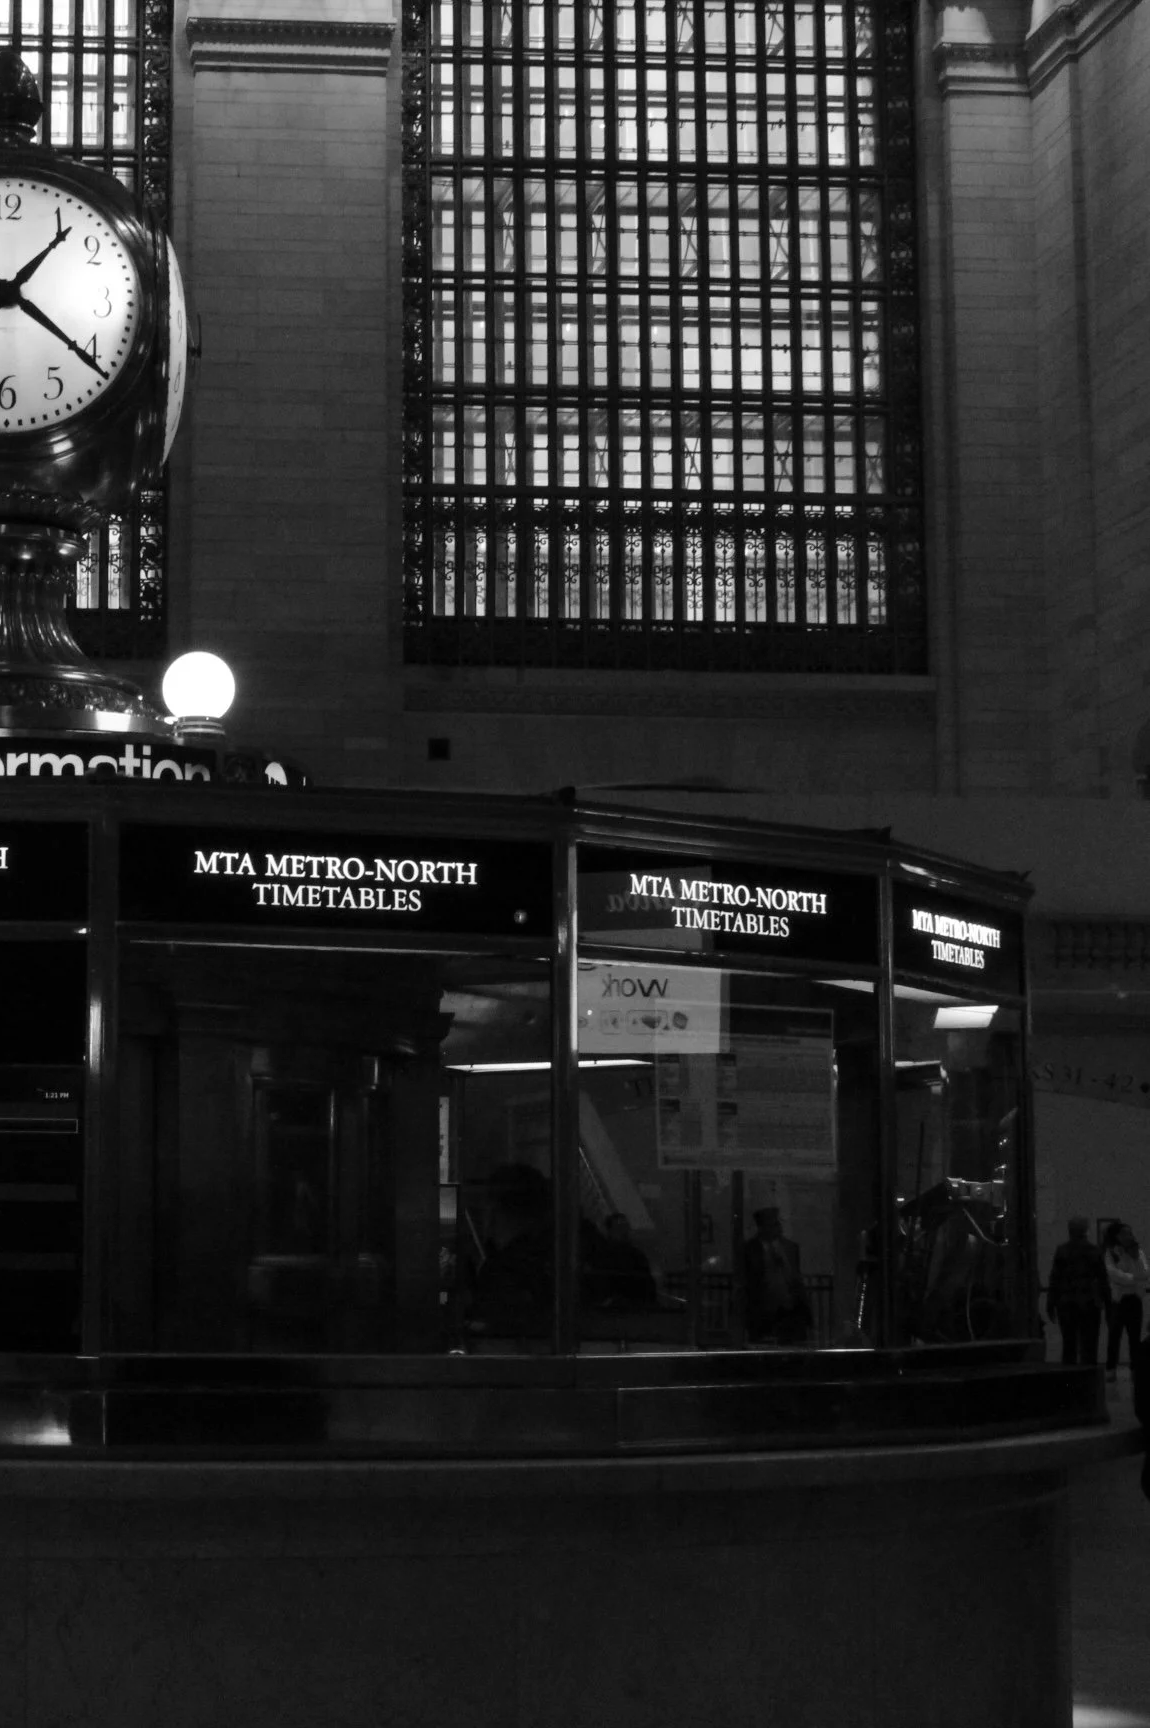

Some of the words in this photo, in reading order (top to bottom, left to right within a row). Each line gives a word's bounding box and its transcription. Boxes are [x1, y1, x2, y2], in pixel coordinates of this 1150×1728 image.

[84, 236, 102, 265] 2
[94, 287, 112, 318] 3
[44, 366, 64, 399] 5
[194, 851, 256, 875] MTA
[264, 853, 477, 886] METRO-NORTH
[253, 881, 423, 911] TIMETABLES
[630, 874, 674, 899] MTA
[680, 879, 827, 914] METRO-NORTH
[671, 906, 791, 938] TIMETABLES
[911, 909, 933, 933] MTA
[934, 912, 1001, 949] METRO-NORTH
[931, 940, 985, 970] TIMETABLES
